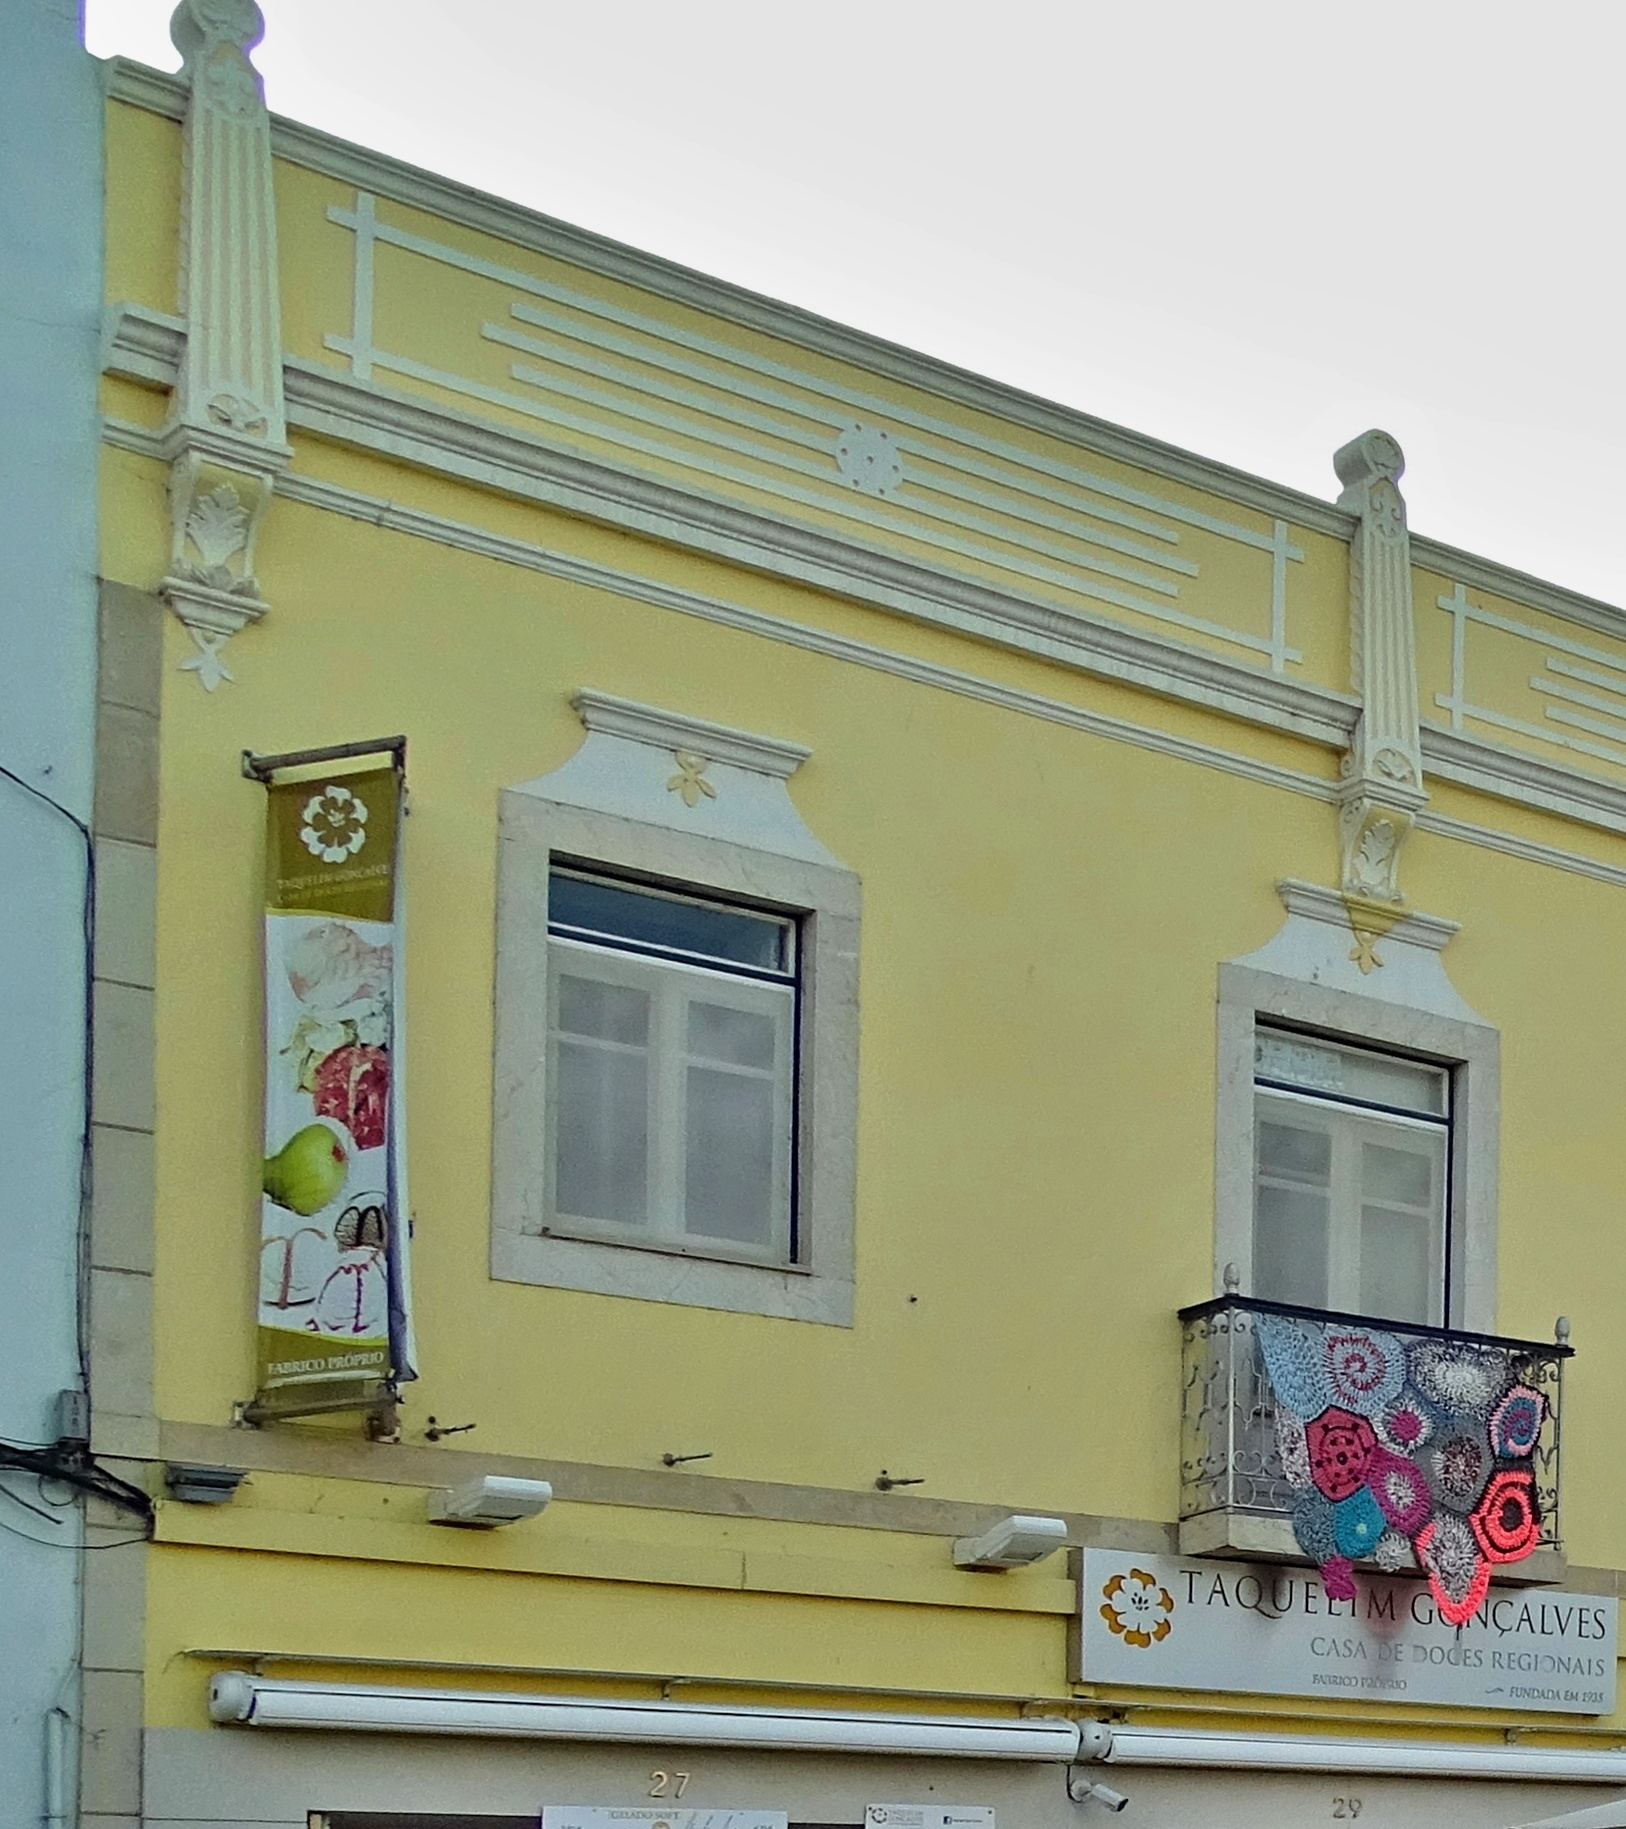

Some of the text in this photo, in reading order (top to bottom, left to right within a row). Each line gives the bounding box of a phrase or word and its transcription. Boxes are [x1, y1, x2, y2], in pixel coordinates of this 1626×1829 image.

[268, 1350, 384, 1375] FABRICO PRÓPRIO
[1179, 1570, 1396, 1621] TAQUELIM
[1310, 1637, 1605, 1678] CASA DE DOCES REGIONAIS
[1312, 1674, 1358, 1688] FABRICO
[1509, 1686, 1604, 1704] FUNDADA EM 1935
[649, 1771, 690, 1799] 27
[1332, 1797, 1362, 1819] 29
